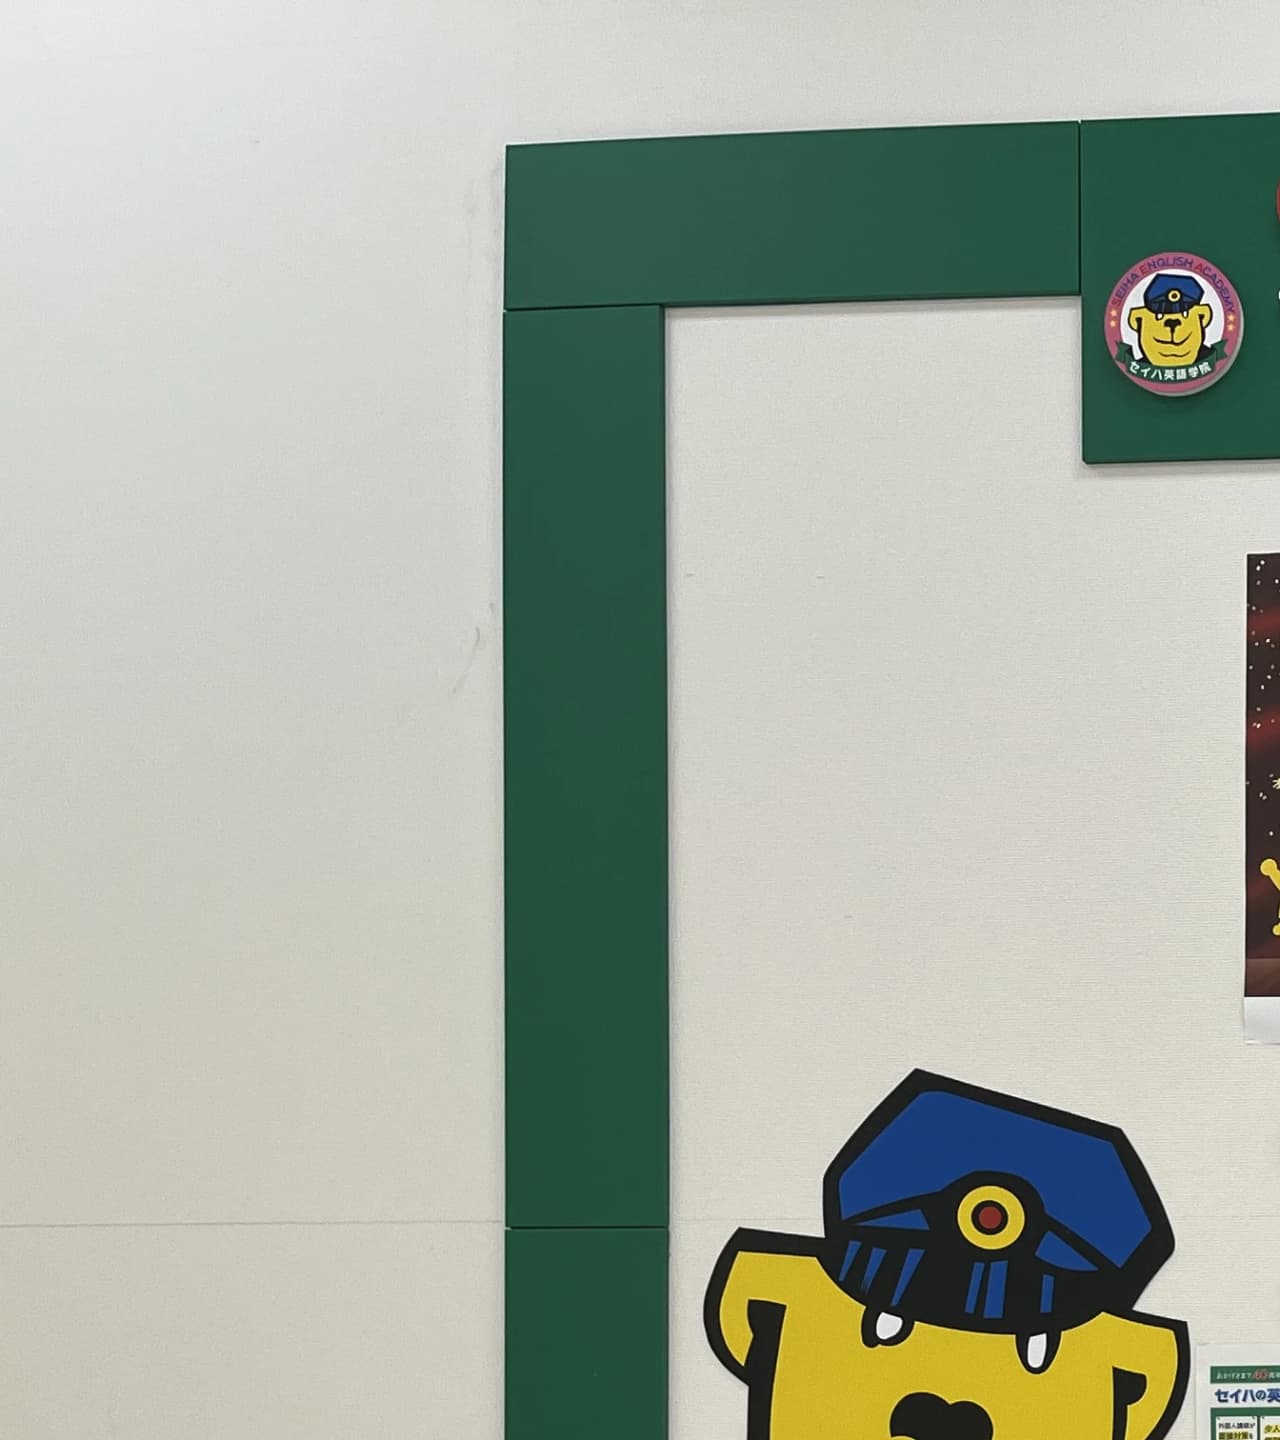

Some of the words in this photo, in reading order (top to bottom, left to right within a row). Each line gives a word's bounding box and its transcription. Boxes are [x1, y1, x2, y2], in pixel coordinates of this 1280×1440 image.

[1111, 273, 1139, 306] SEIHA
[1140, 256, 1194, 277] ENGLISH
[1193, 263, 1236, 313] ACADEMY
[1129, 361, 1212, 381] セイハ英語学院
